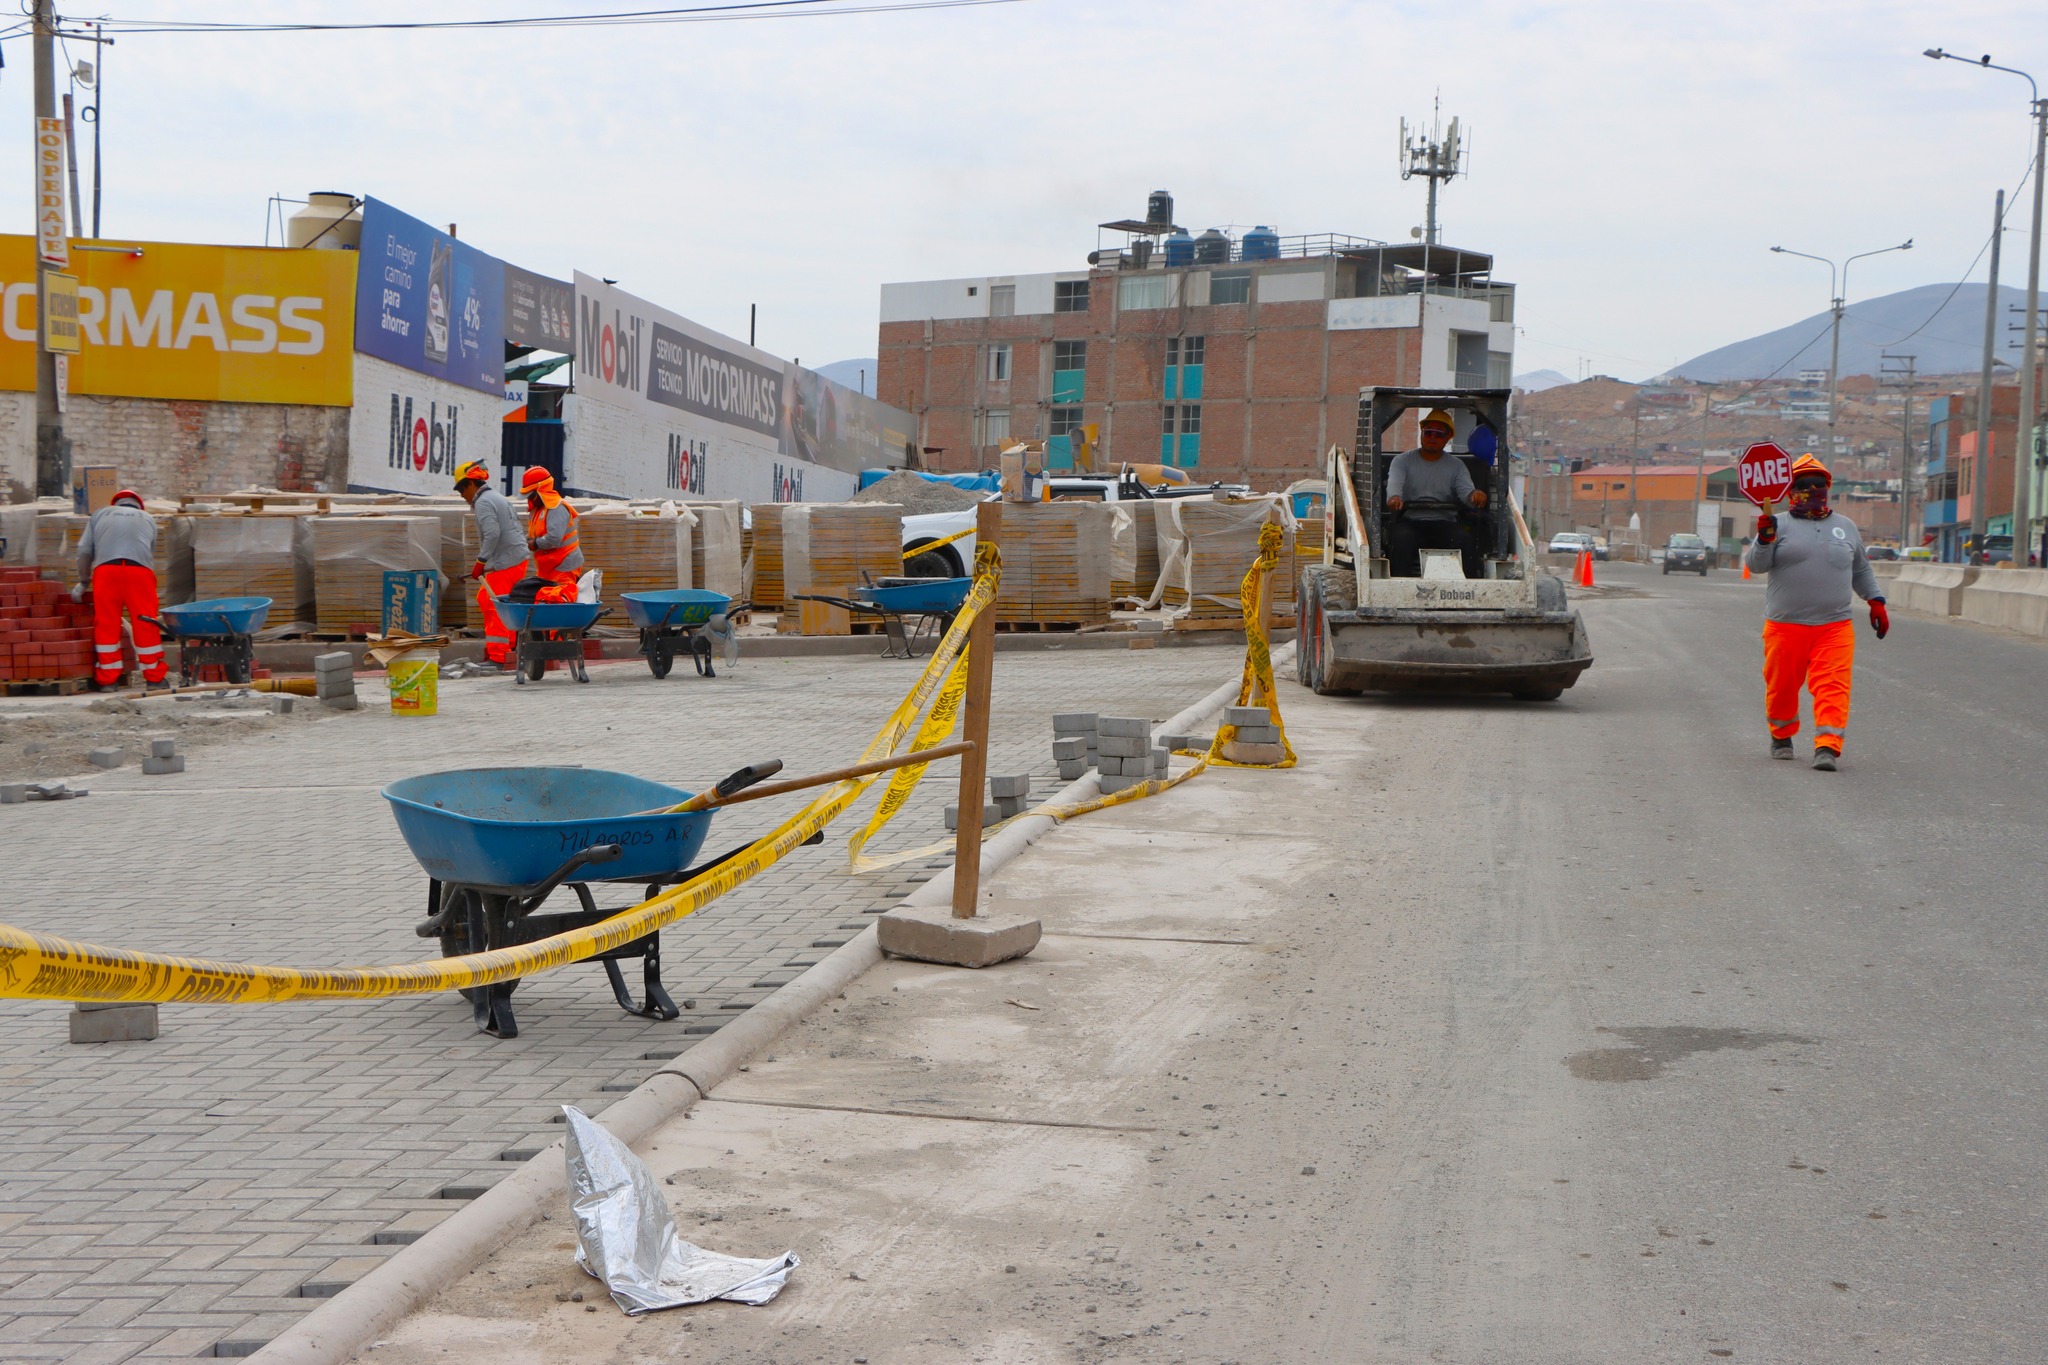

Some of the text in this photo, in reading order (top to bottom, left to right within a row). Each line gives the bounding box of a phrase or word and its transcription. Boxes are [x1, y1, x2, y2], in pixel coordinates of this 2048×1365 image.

[40, 119, 61, 252] HOSPEDAJE
[386, 234, 417, 270] El mejor
[384, 264, 412, 290] camino
[382, 288, 401, 309] para
[0, 281, 325, 356] ORMASS
[381, 312, 410, 337] ahorrar
[580, 294, 641, 392] Mobil
[656, 337, 683, 367] SERVICIO
[657, 367, 683, 396] TÉCNICO
[686, 348, 776, 427] MOTORMASS
[388, 393, 458, 477] Mobil
[667, 432, 706, 496] Mobil
[1741, 457, 1789, 489] PARE
[773, 462, 803, 503] Mobil
[1440, 589, 1475, 600] Bobcat
[168, 975, 250, 1002] OBRAS
